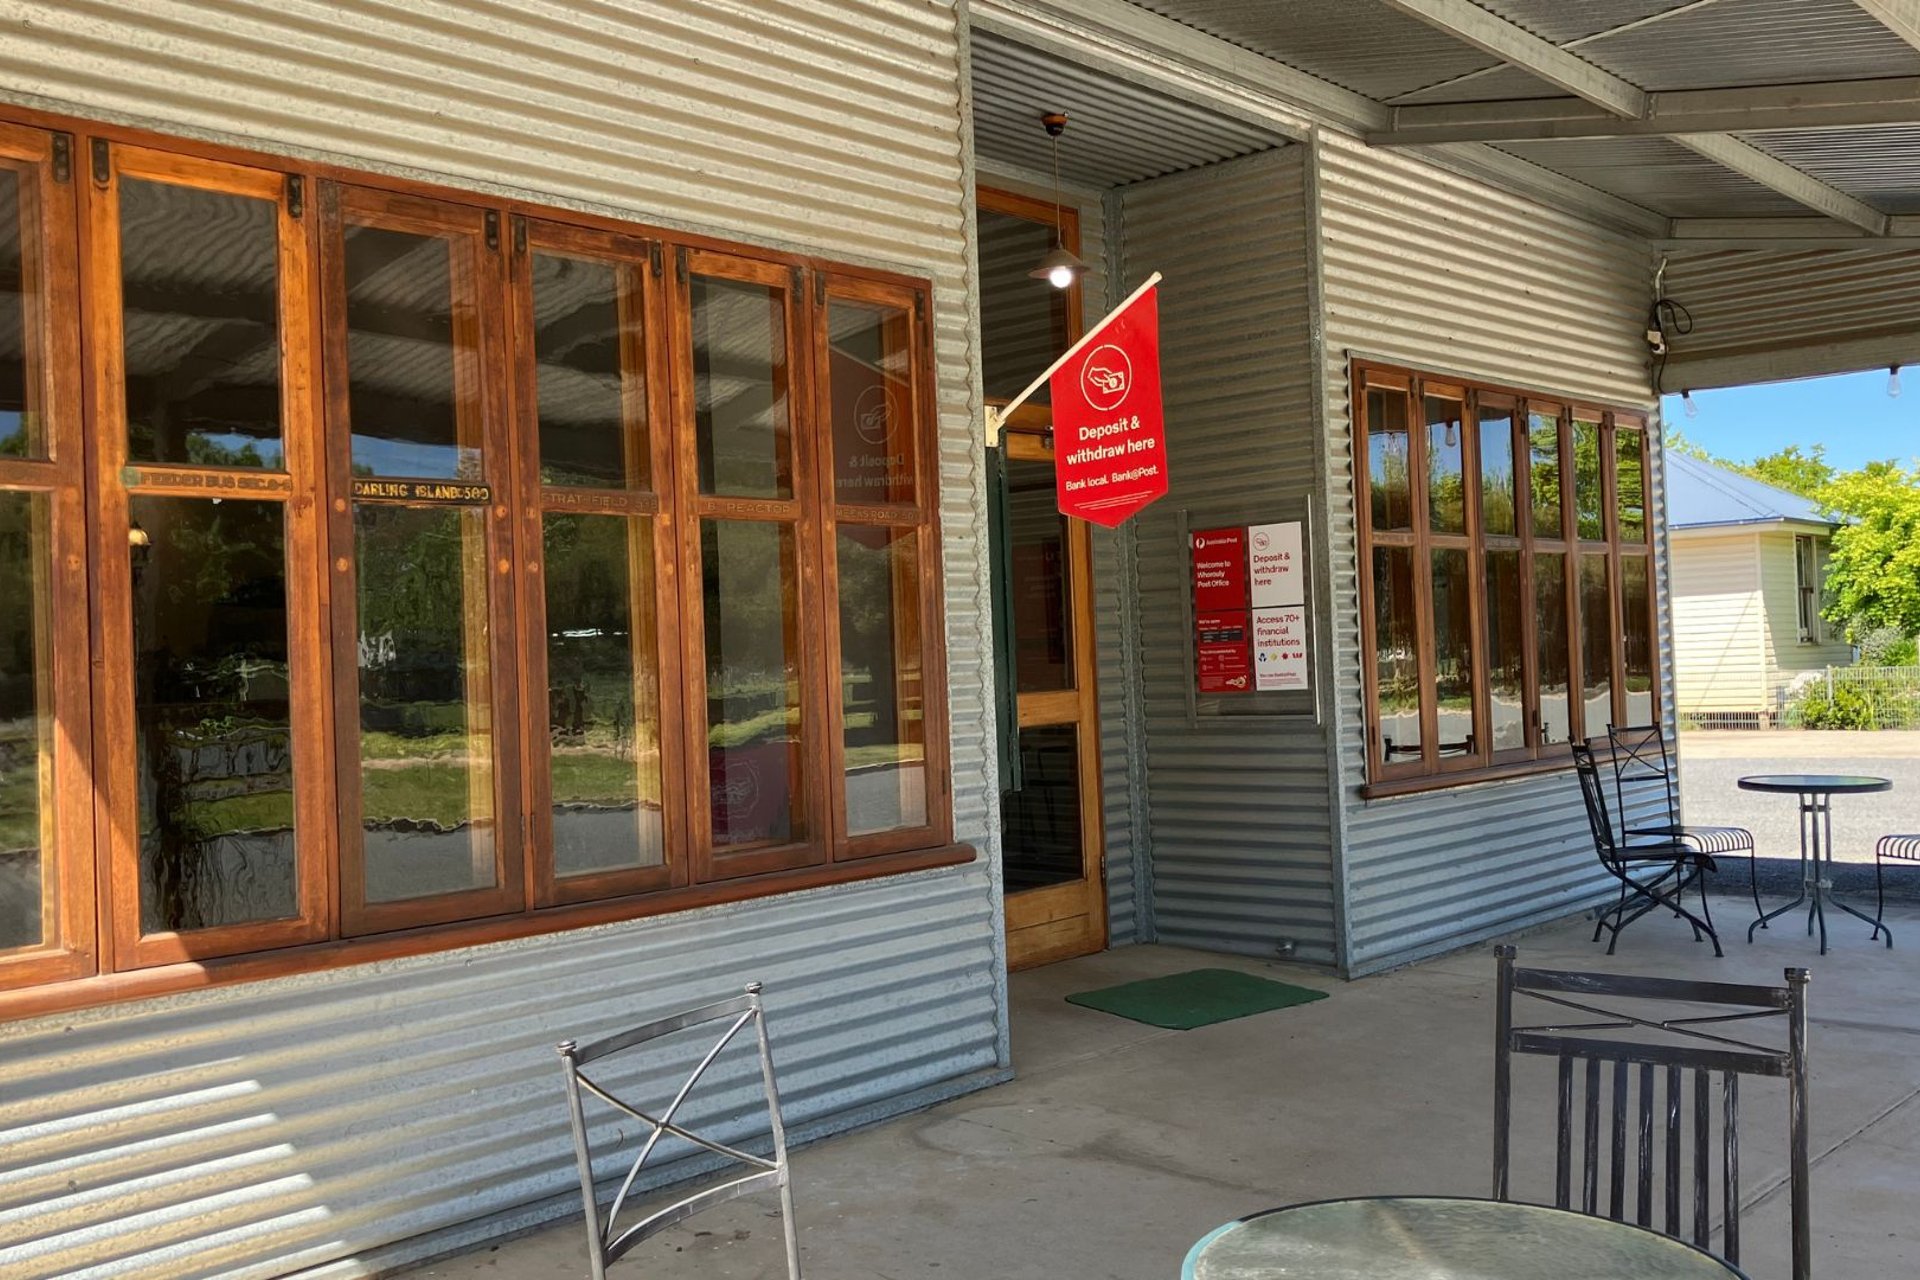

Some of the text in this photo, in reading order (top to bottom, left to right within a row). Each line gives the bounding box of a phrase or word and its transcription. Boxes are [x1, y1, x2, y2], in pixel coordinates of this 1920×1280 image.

[1078, 415, 1140, 441] Deposit &
[1066, 437, 1155, 465] withdraw here
[1065, 479, 1086, 491] Bank
[1087, 474, 1109, 487] local.
[354, 482, 409, 498] DARLING
[725, 502, 791, 513] REACTOR
[1253, 551, 1290, 563] Deposit &
[1196, 560, 1231, 569] Welcome to
[1253, 565, 1289, 575] withdraw
[1211, 579, 1230, 587] Office
[1254, 577, 1272, 586] here
[1256, 614, 1300, 624] Access 70+
[1257, 626, 1289, 636] financial
[1257, 638, 1300, 647] institutions
